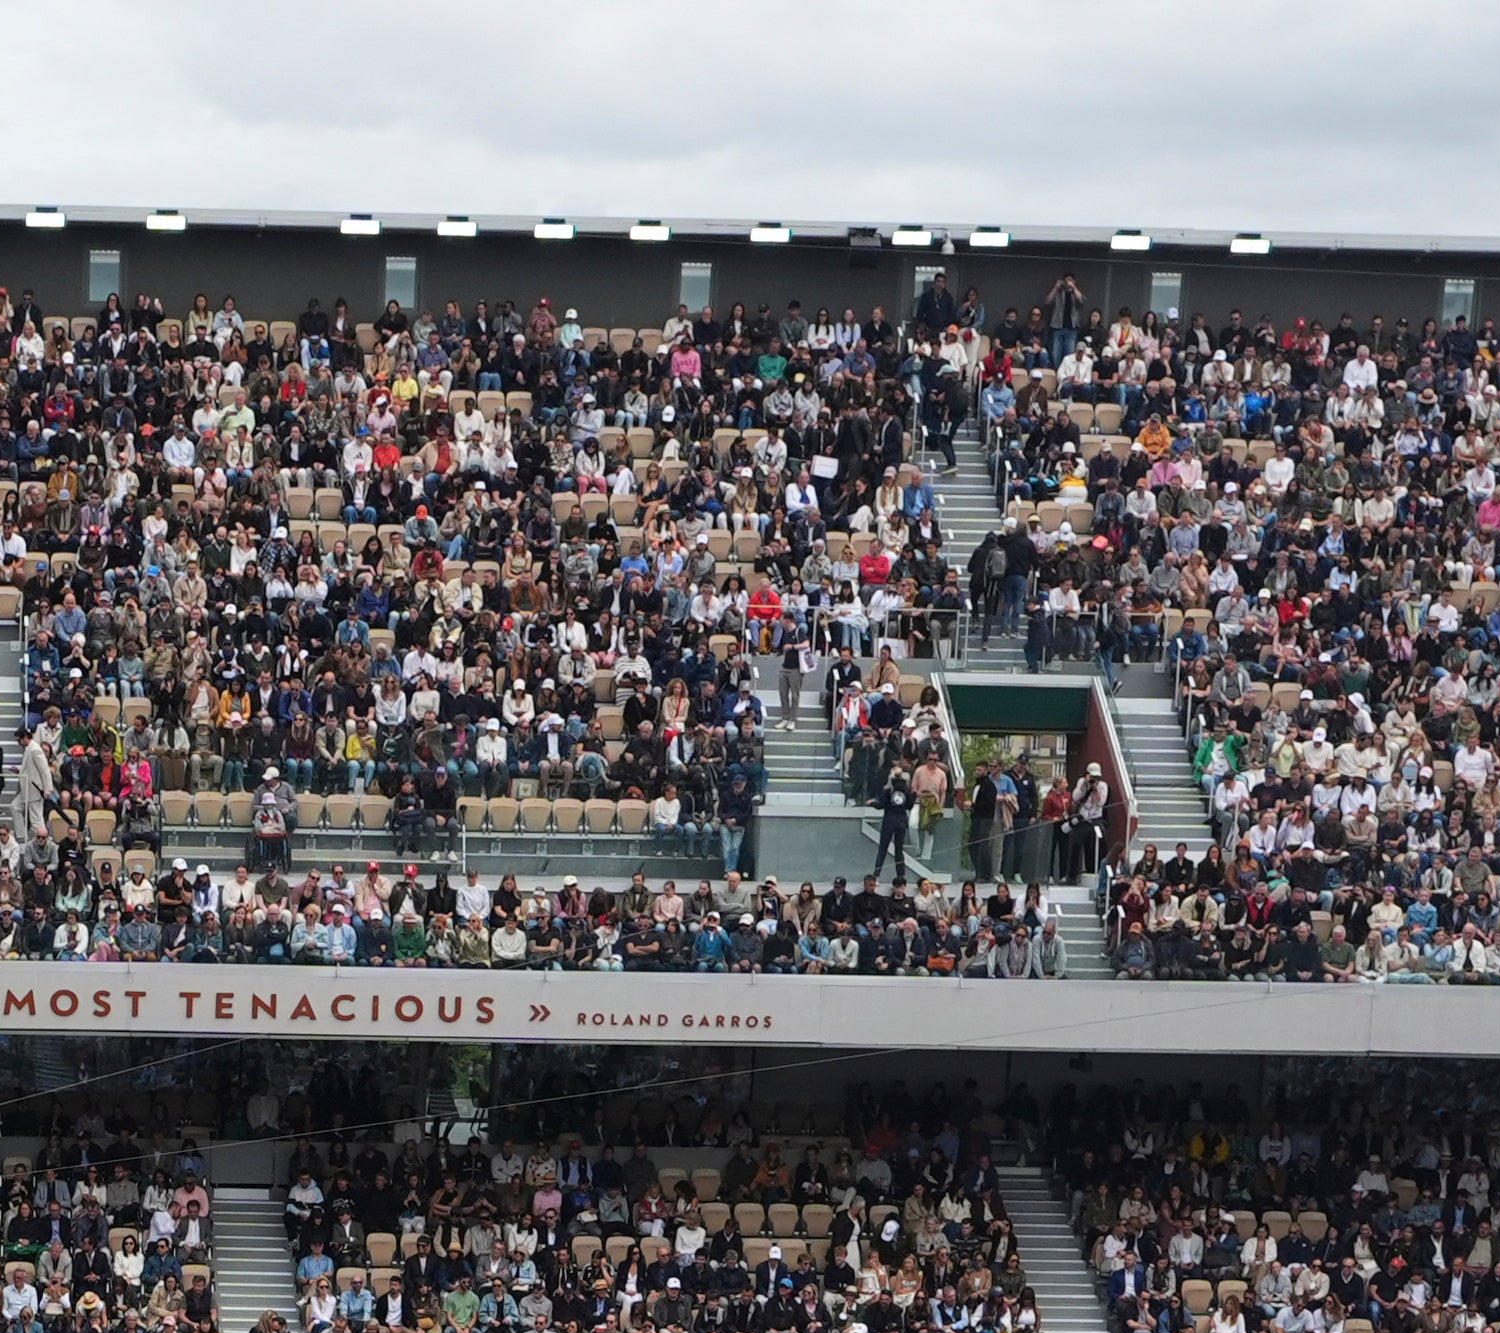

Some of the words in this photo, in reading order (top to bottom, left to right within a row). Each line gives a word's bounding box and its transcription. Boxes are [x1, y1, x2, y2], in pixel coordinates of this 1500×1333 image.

[2, 988, 147, 1018] MOST
[179, 991, 495, 1024] TENACIOUS
[577, 1012, 669, 1027] ROLAND
[681, 1013, 773, 1029] GARROS
